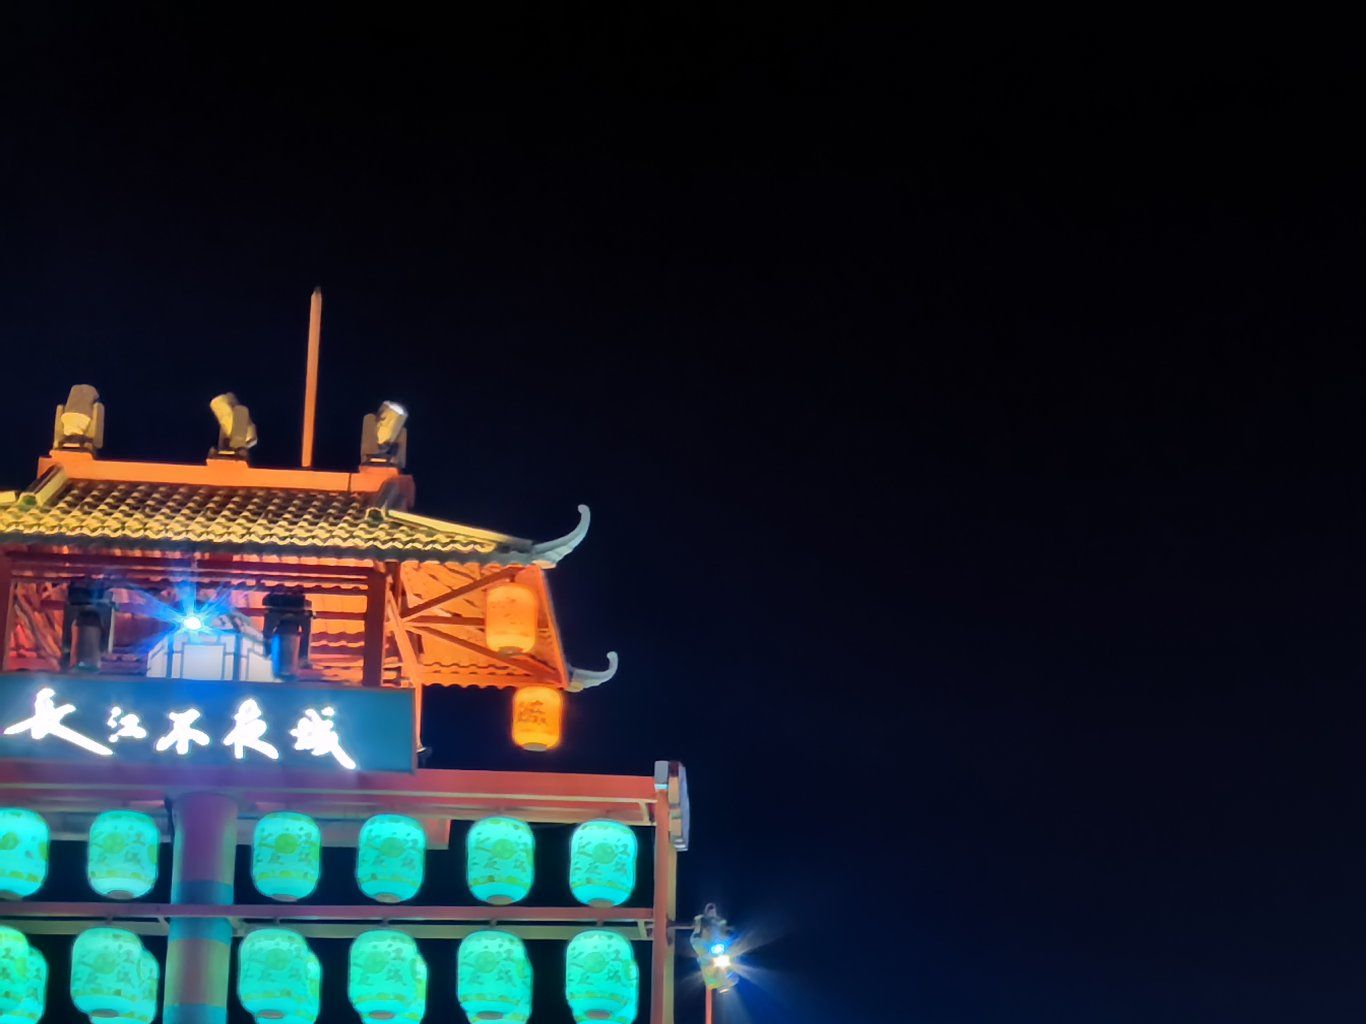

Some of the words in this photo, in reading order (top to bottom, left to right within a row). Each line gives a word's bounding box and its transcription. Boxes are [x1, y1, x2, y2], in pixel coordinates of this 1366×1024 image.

[4, 686, 357, 770] 长江不夜城
